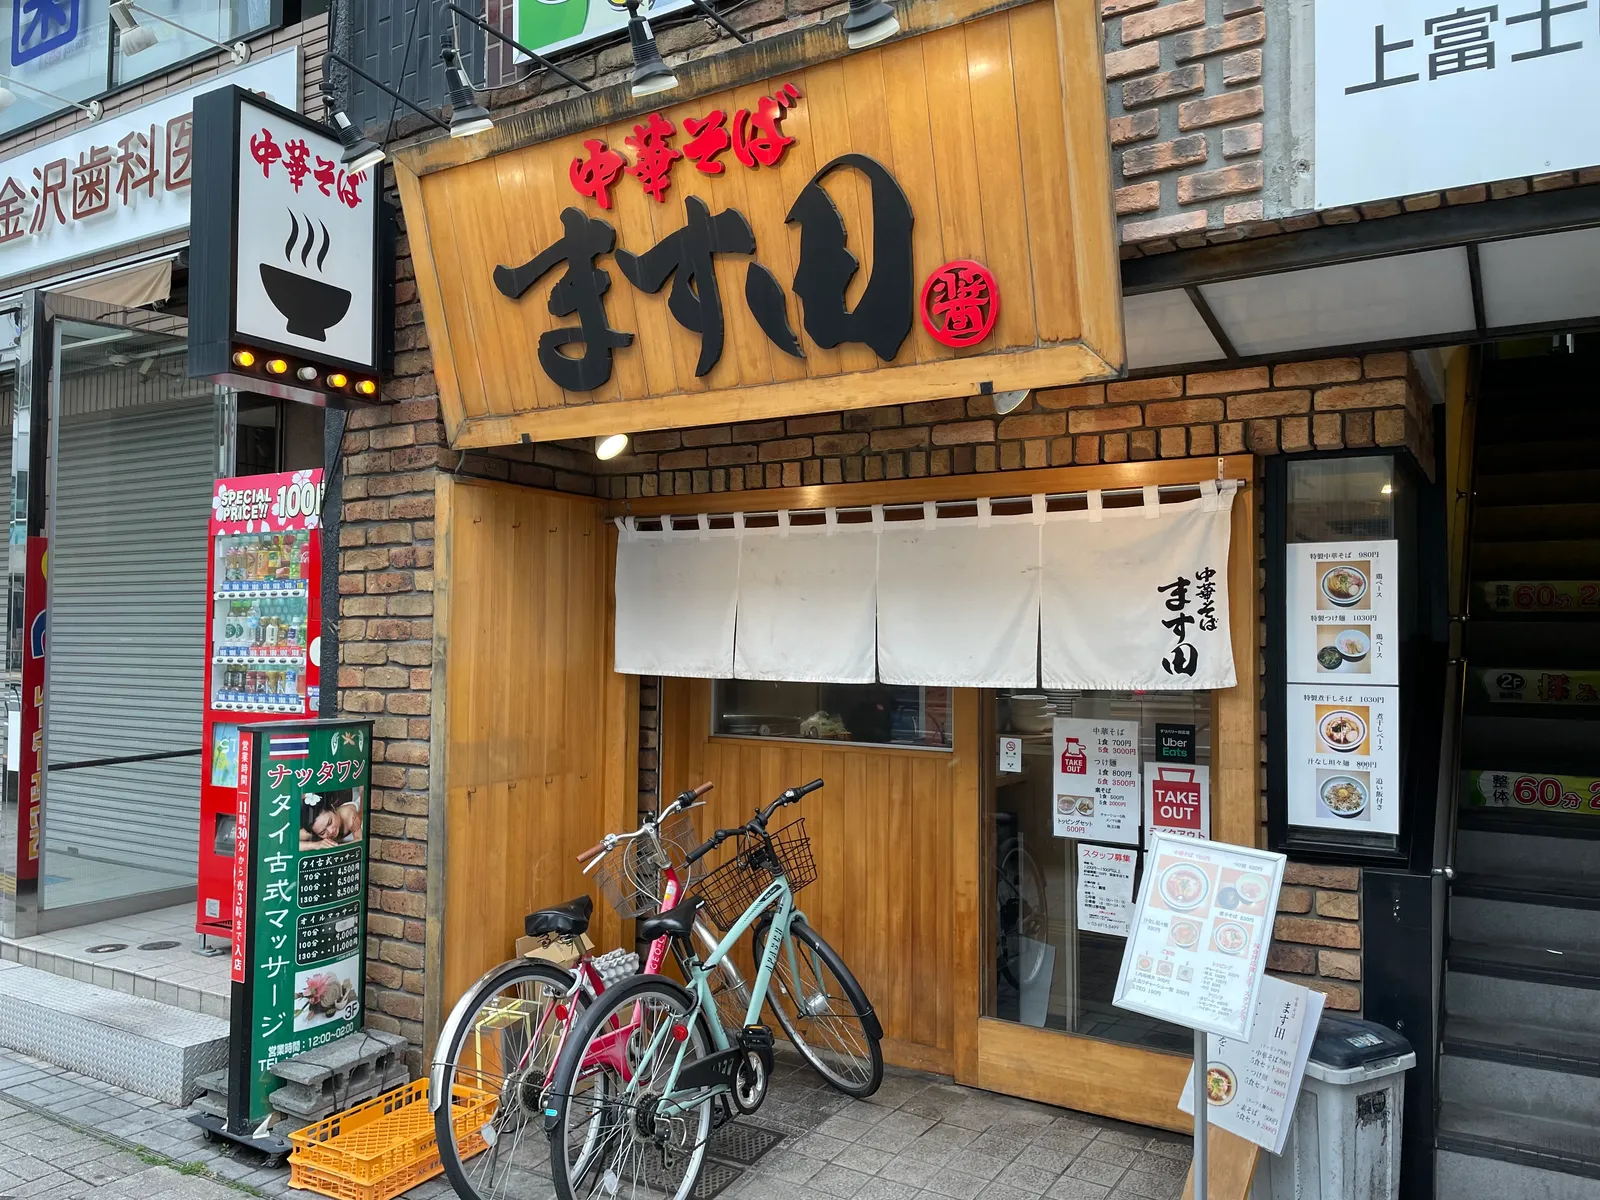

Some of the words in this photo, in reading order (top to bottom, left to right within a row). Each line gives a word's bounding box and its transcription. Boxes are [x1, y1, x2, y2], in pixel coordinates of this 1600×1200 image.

[569, 82, 802, 210] 中華そば
[250, 127, 367, 209] 中華そば
[492, 152, 914, 392] ます田
[220, 486, 272, 506] SPECIAL
[1195, 566, 1219, 631] 中華そば
[1157, 576, 1198, 677] ます田
[1500, 674, 1523, 689] 2F
[1093, 727, 1125, 736] 中華そば
[1112, 739, 1132, 747] 700円
[1162, 737, 1188, 748] Uber
[1112, 747, 1136, 756] 3000円
[1162, 747, 1188, 757] Eats
[240, 740, 249, 786] 営業時間
[1065, 758, 1083, 767] TAKE
[1066, 765, 1081, 773] OUT
[267, 759, 366, 789] ナッタワン
[1112, 769, 1132, 778] 800円
[1112, 779, 1136, 788] 3500円
[1492, 774, 1509, 803] 整体
[1513, 776, 1581, 809] 60分
[1154, 789, 1199, 805] TAKE
[1160, 805, 1194, 821] OUT
[1057, 817, 1093, 827] トッピングセット
[1083, 849, 1131, 863] スタッフ募集
[260, 793, 293, 1038] タイ古式マッサージ
[345, 1003, 358, 1019] 3F
